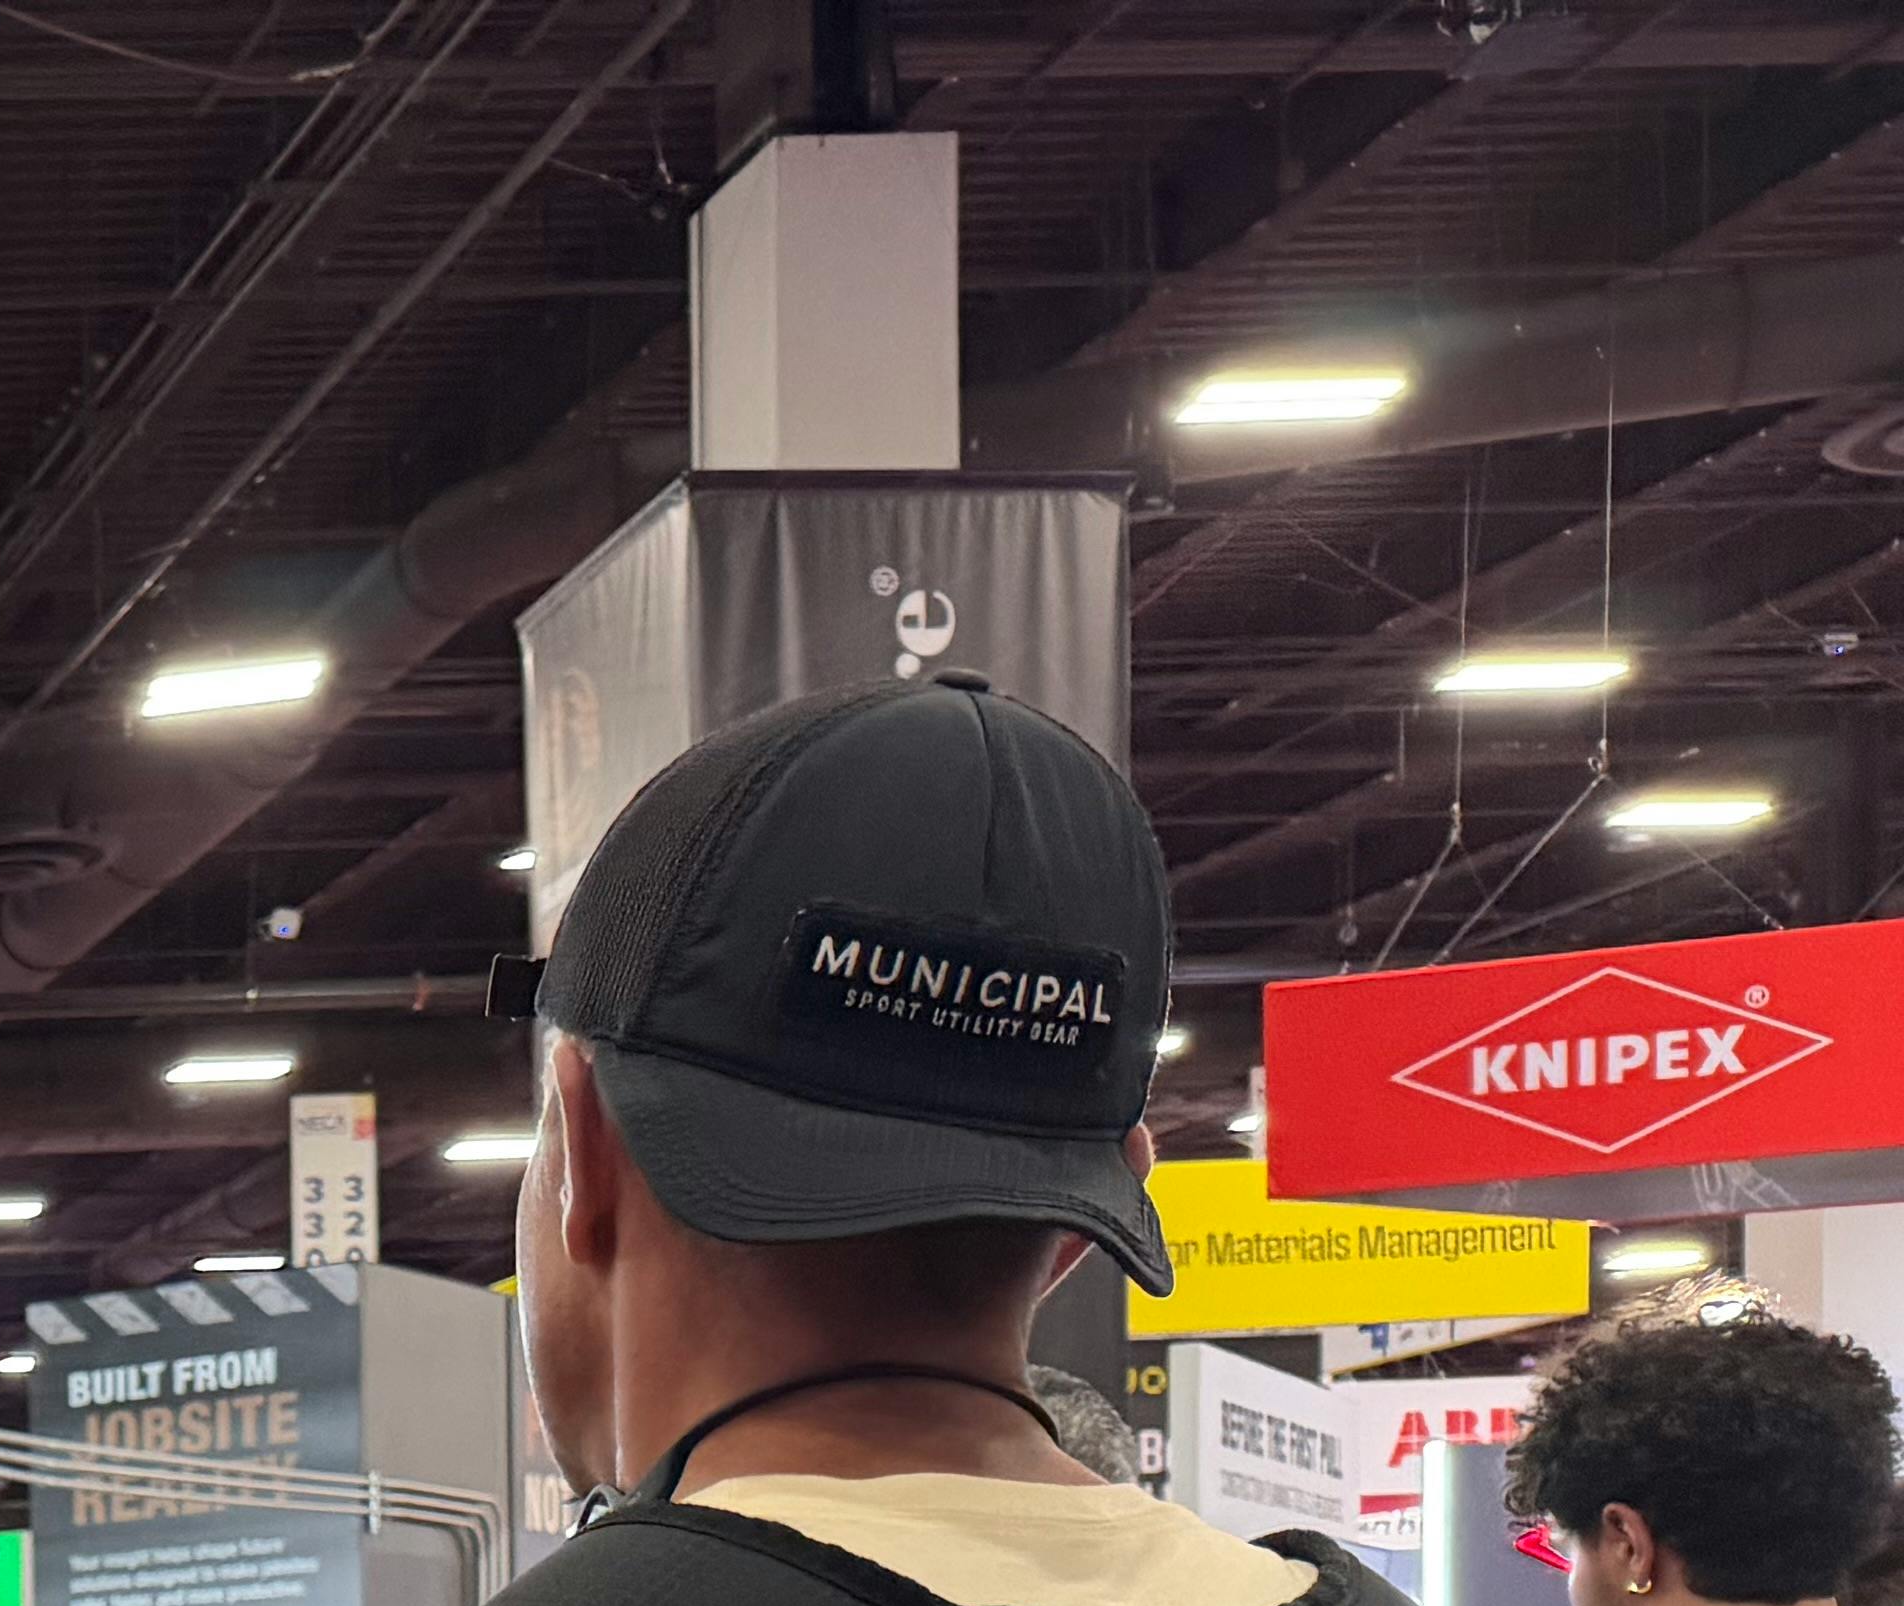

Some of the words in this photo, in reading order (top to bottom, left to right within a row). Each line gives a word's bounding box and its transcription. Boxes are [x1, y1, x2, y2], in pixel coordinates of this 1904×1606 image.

[812, 935, 1111, 1025] MUNICIPAL
[844, 988, 921, 1021] SPORT
[932, 1007, 1023, 1037] UTILITY
[1029, 1022, 1080, 1046] GEAR
[1468, 1023, 1747, 1095] KNIPEX
[1205, 1229, 1351, 1267] Materials
[1357, 1217, 1559, 1264] Management
[68, 1360, 167, 1409] BUILT
[172, 1346, 278, 1396] FROM
